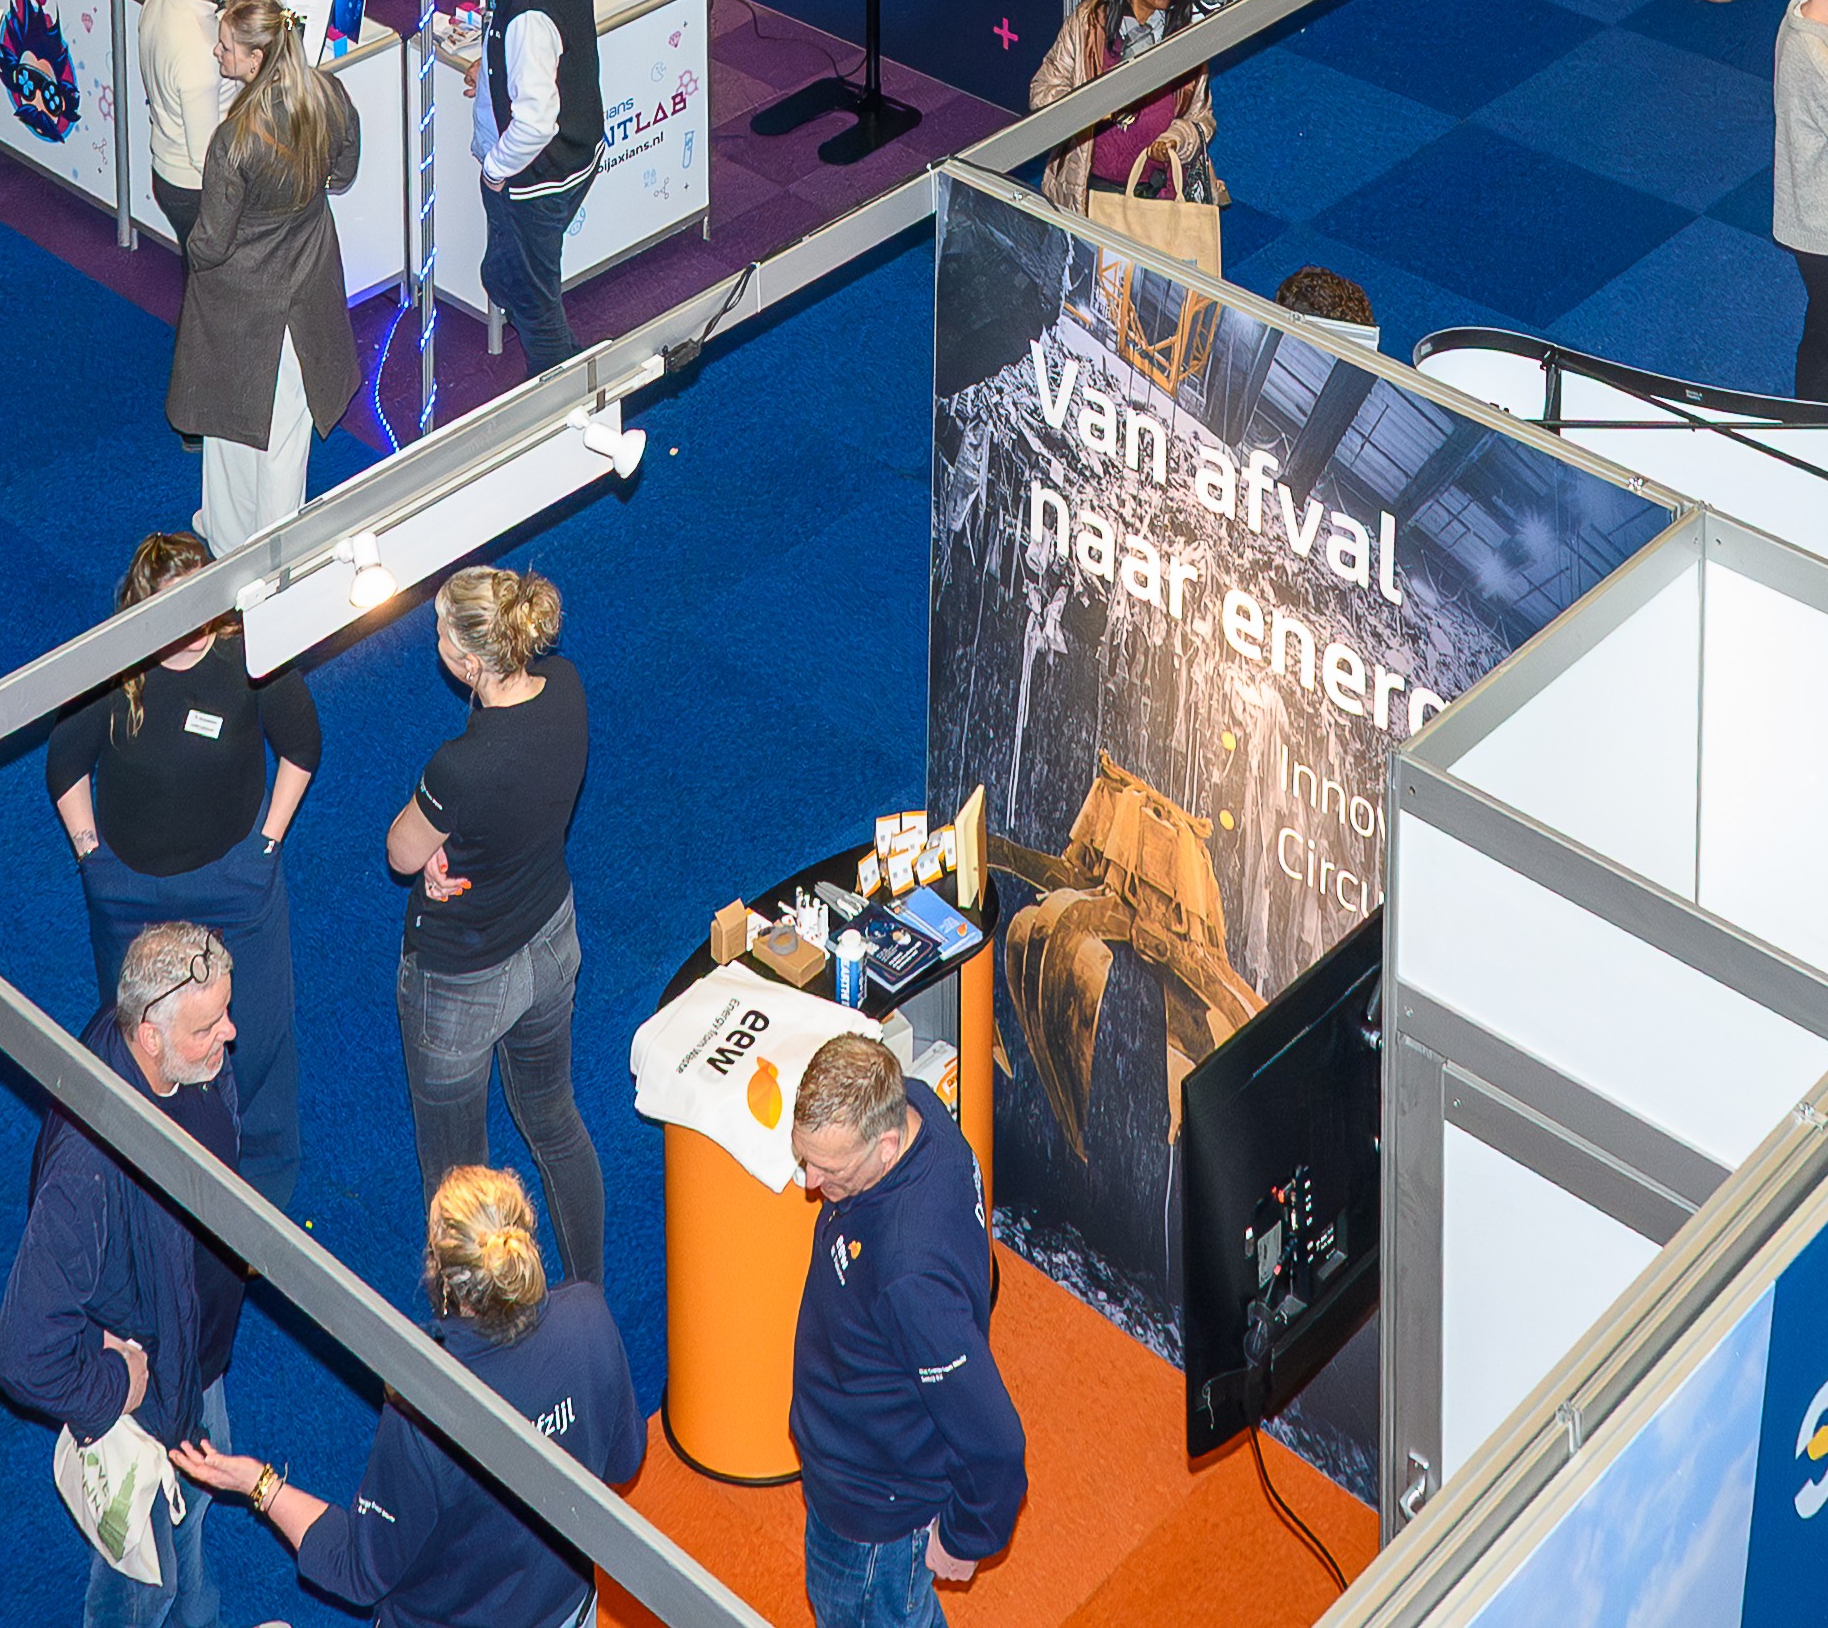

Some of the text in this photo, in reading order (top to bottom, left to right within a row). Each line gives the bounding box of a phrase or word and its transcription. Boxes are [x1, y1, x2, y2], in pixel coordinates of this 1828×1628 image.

[1028, 338, 1405, 607] Van afval
[1031, 478, 1200, 621] naar
[677, 997, 741, 1075] Energy from Waste
[706, 1007, 771, 1077] eew
